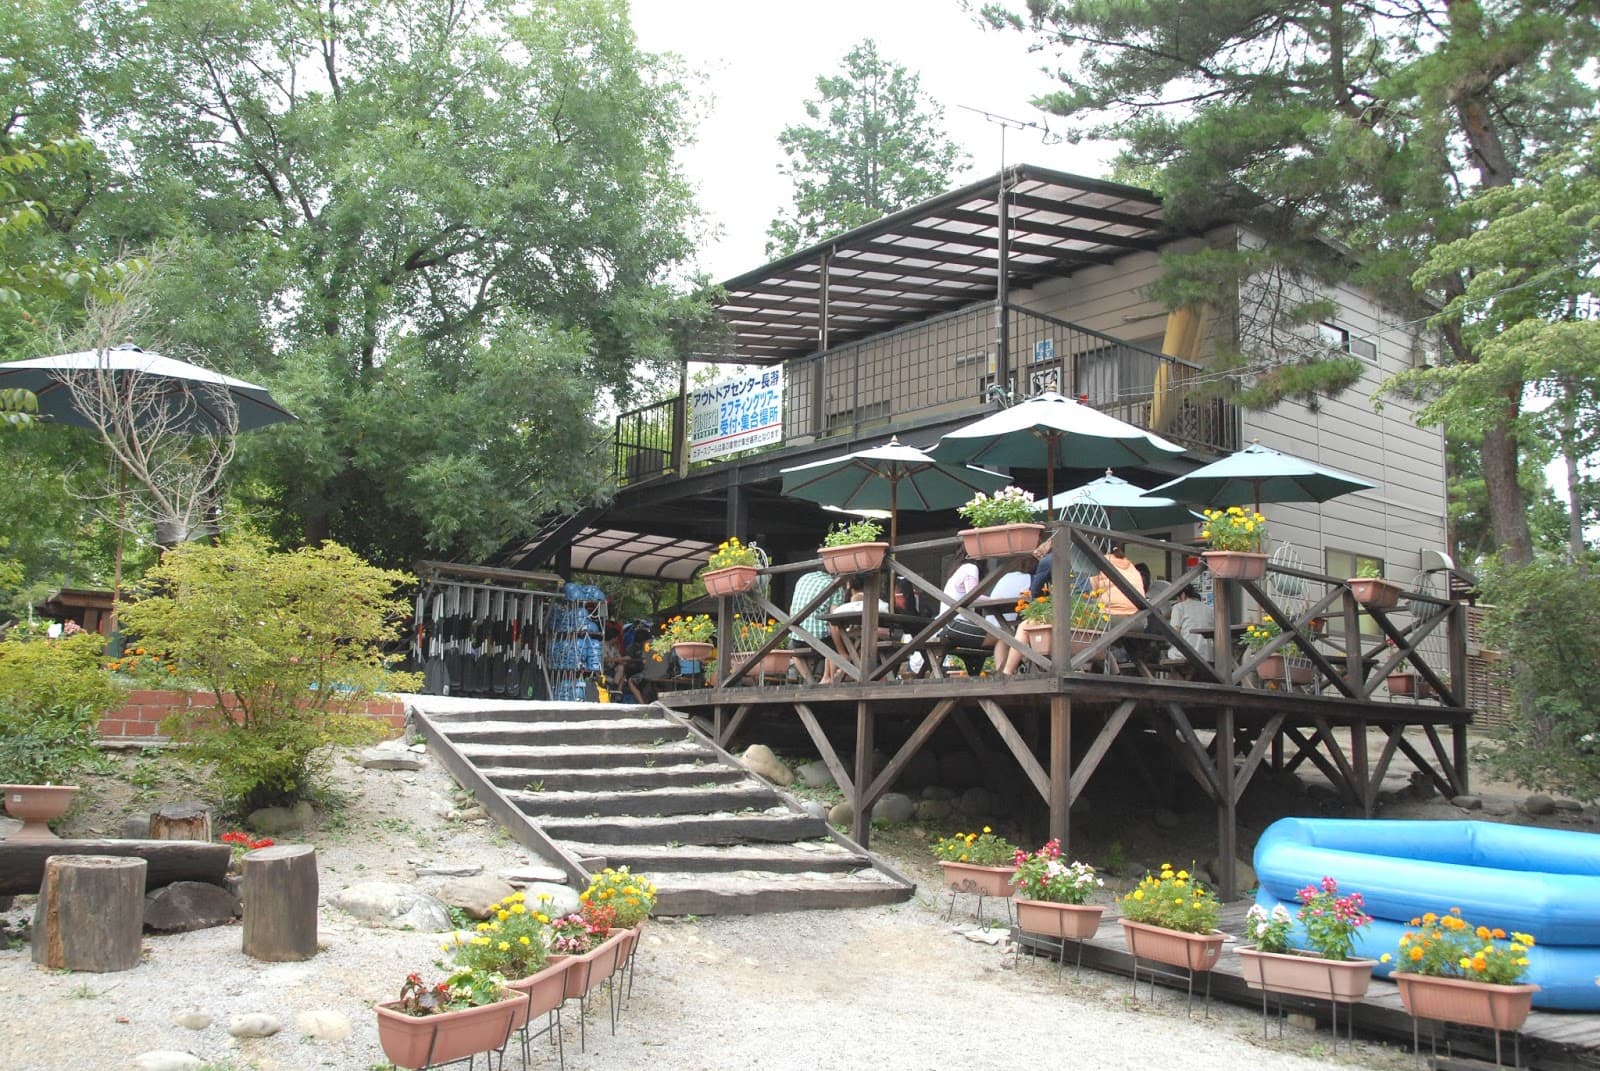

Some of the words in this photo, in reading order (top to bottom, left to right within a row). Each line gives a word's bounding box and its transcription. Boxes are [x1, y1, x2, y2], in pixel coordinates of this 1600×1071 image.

[720, 389, 779, 419] ラフティングツアー
[720, 406, 779, 436] 受付・集合場所
